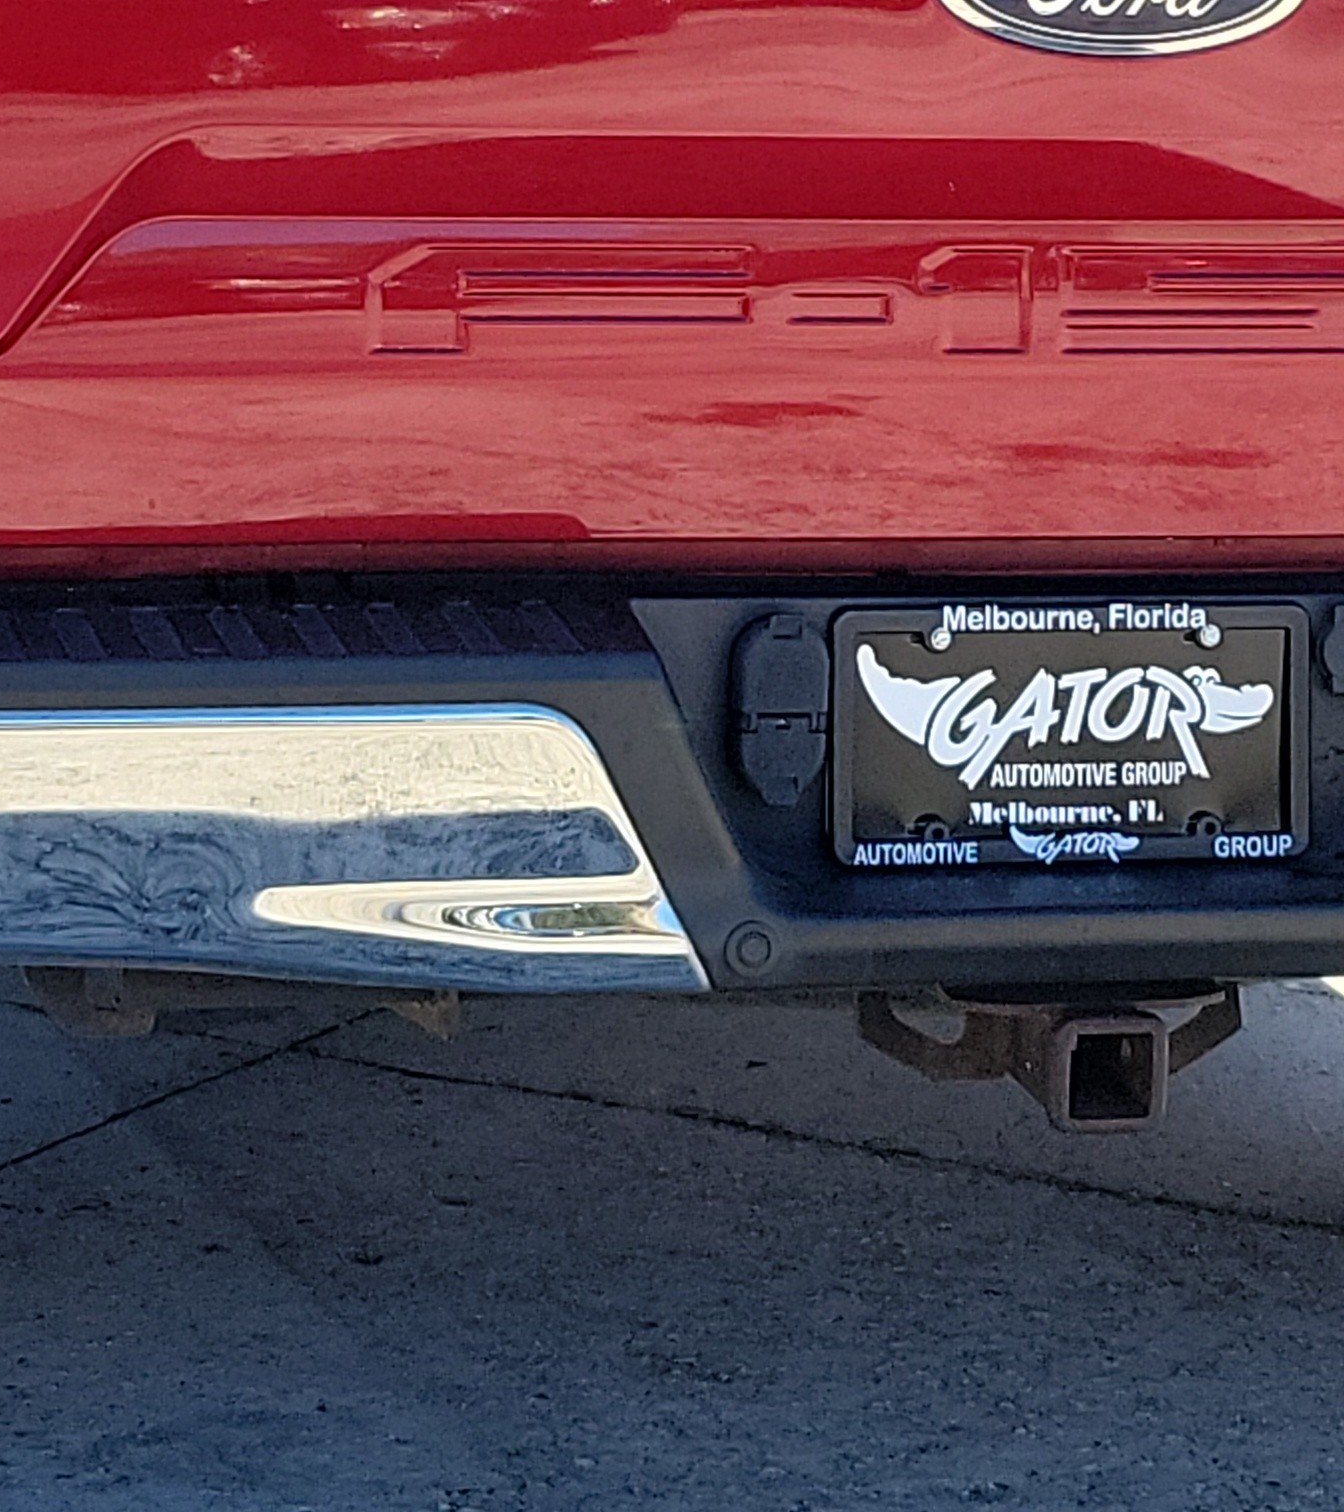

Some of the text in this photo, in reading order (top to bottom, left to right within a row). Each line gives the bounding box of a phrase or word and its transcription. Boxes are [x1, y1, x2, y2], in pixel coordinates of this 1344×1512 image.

[942, 603, 1207, 634] Melbourne, Florida
[928, 667, 1210, 790] GATOR
[990, 761, 1188, 788] AUTOMOTIVE GROUP
[968, 799, 1164, 826] Melbourne, FL
[852, 832, 1294, 866] AUTOMOTIVE GATOR GROUP
